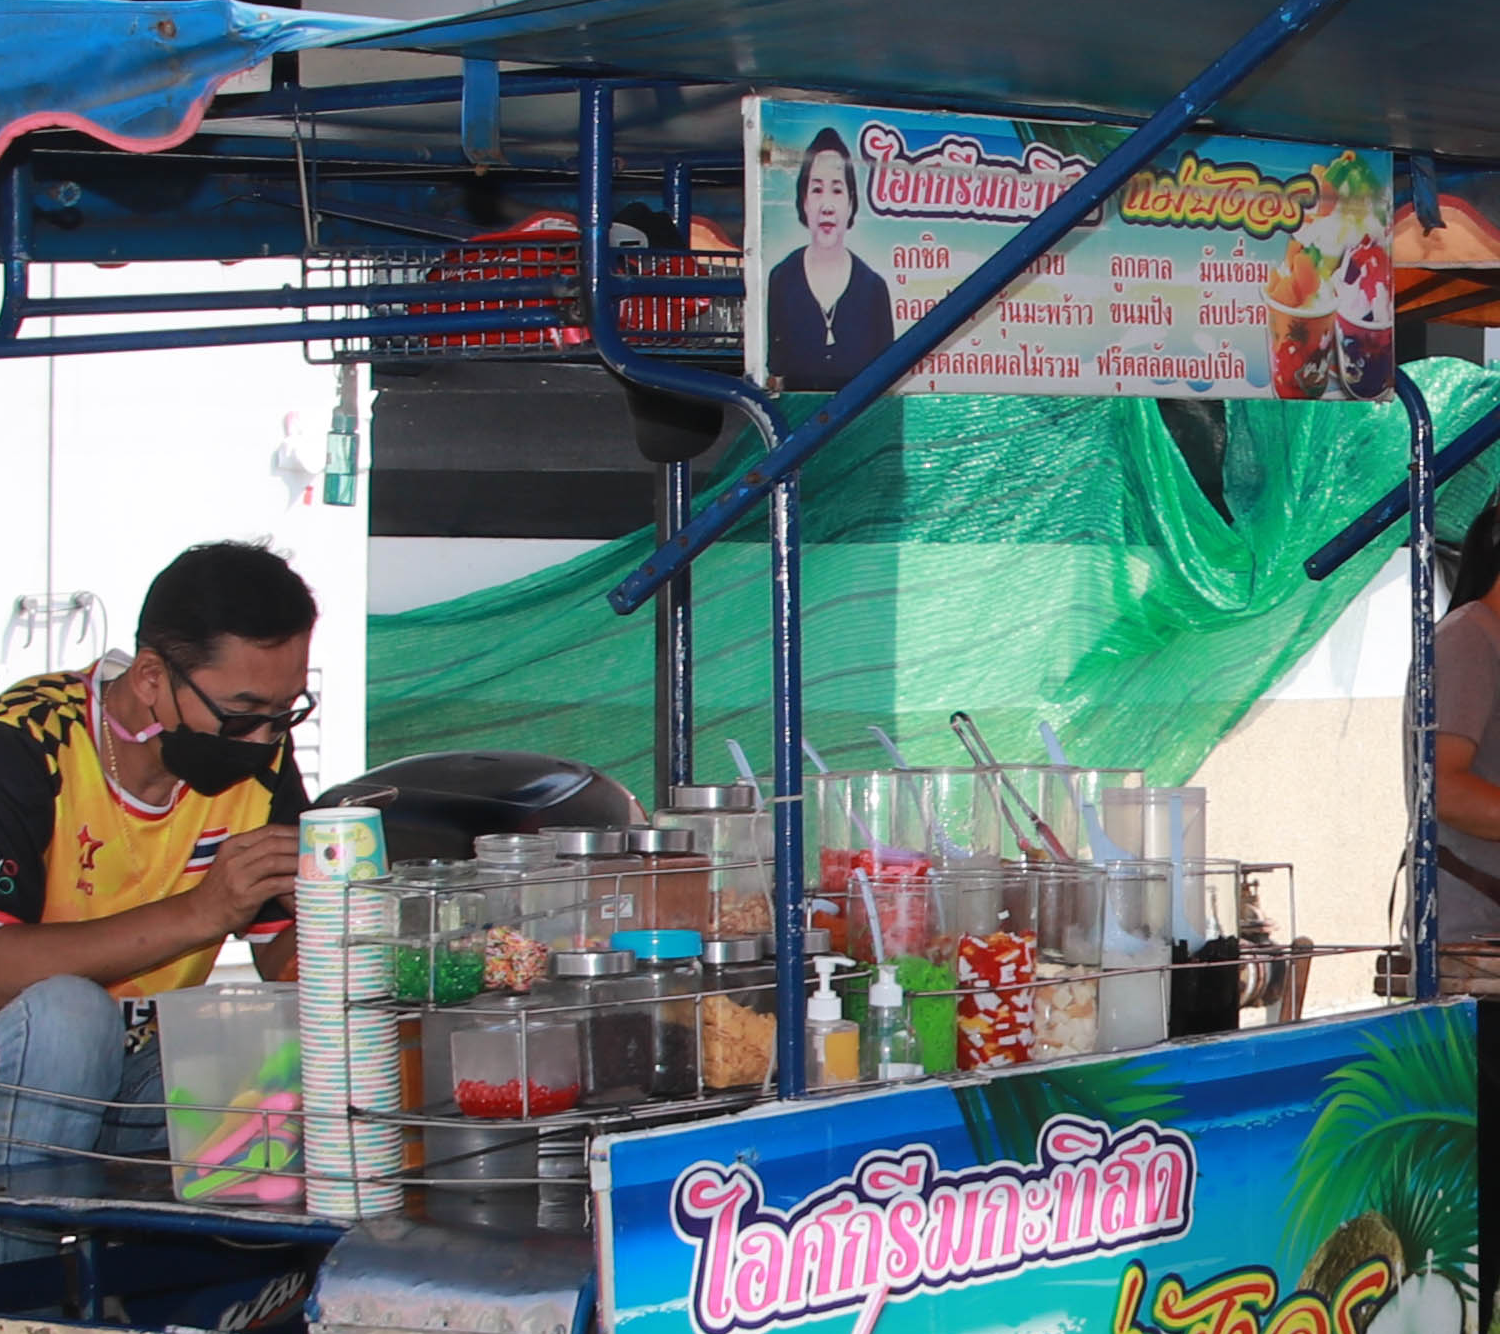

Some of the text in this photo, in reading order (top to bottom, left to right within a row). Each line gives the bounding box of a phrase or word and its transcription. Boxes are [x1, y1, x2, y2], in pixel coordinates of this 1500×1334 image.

[893, 233, 950, 285] ลูกชิด
[1110, 255, 1173, 293] ลูกตาล
[1199, 238, 1269, 284] มันเชื่อม
[1109, 295, 1173, 326] ขนมปัง
[1198, 291, 1268, 326] สับปะรด
[678, 1127, 1190, 1325] ไอศกรีมกะทิสด
